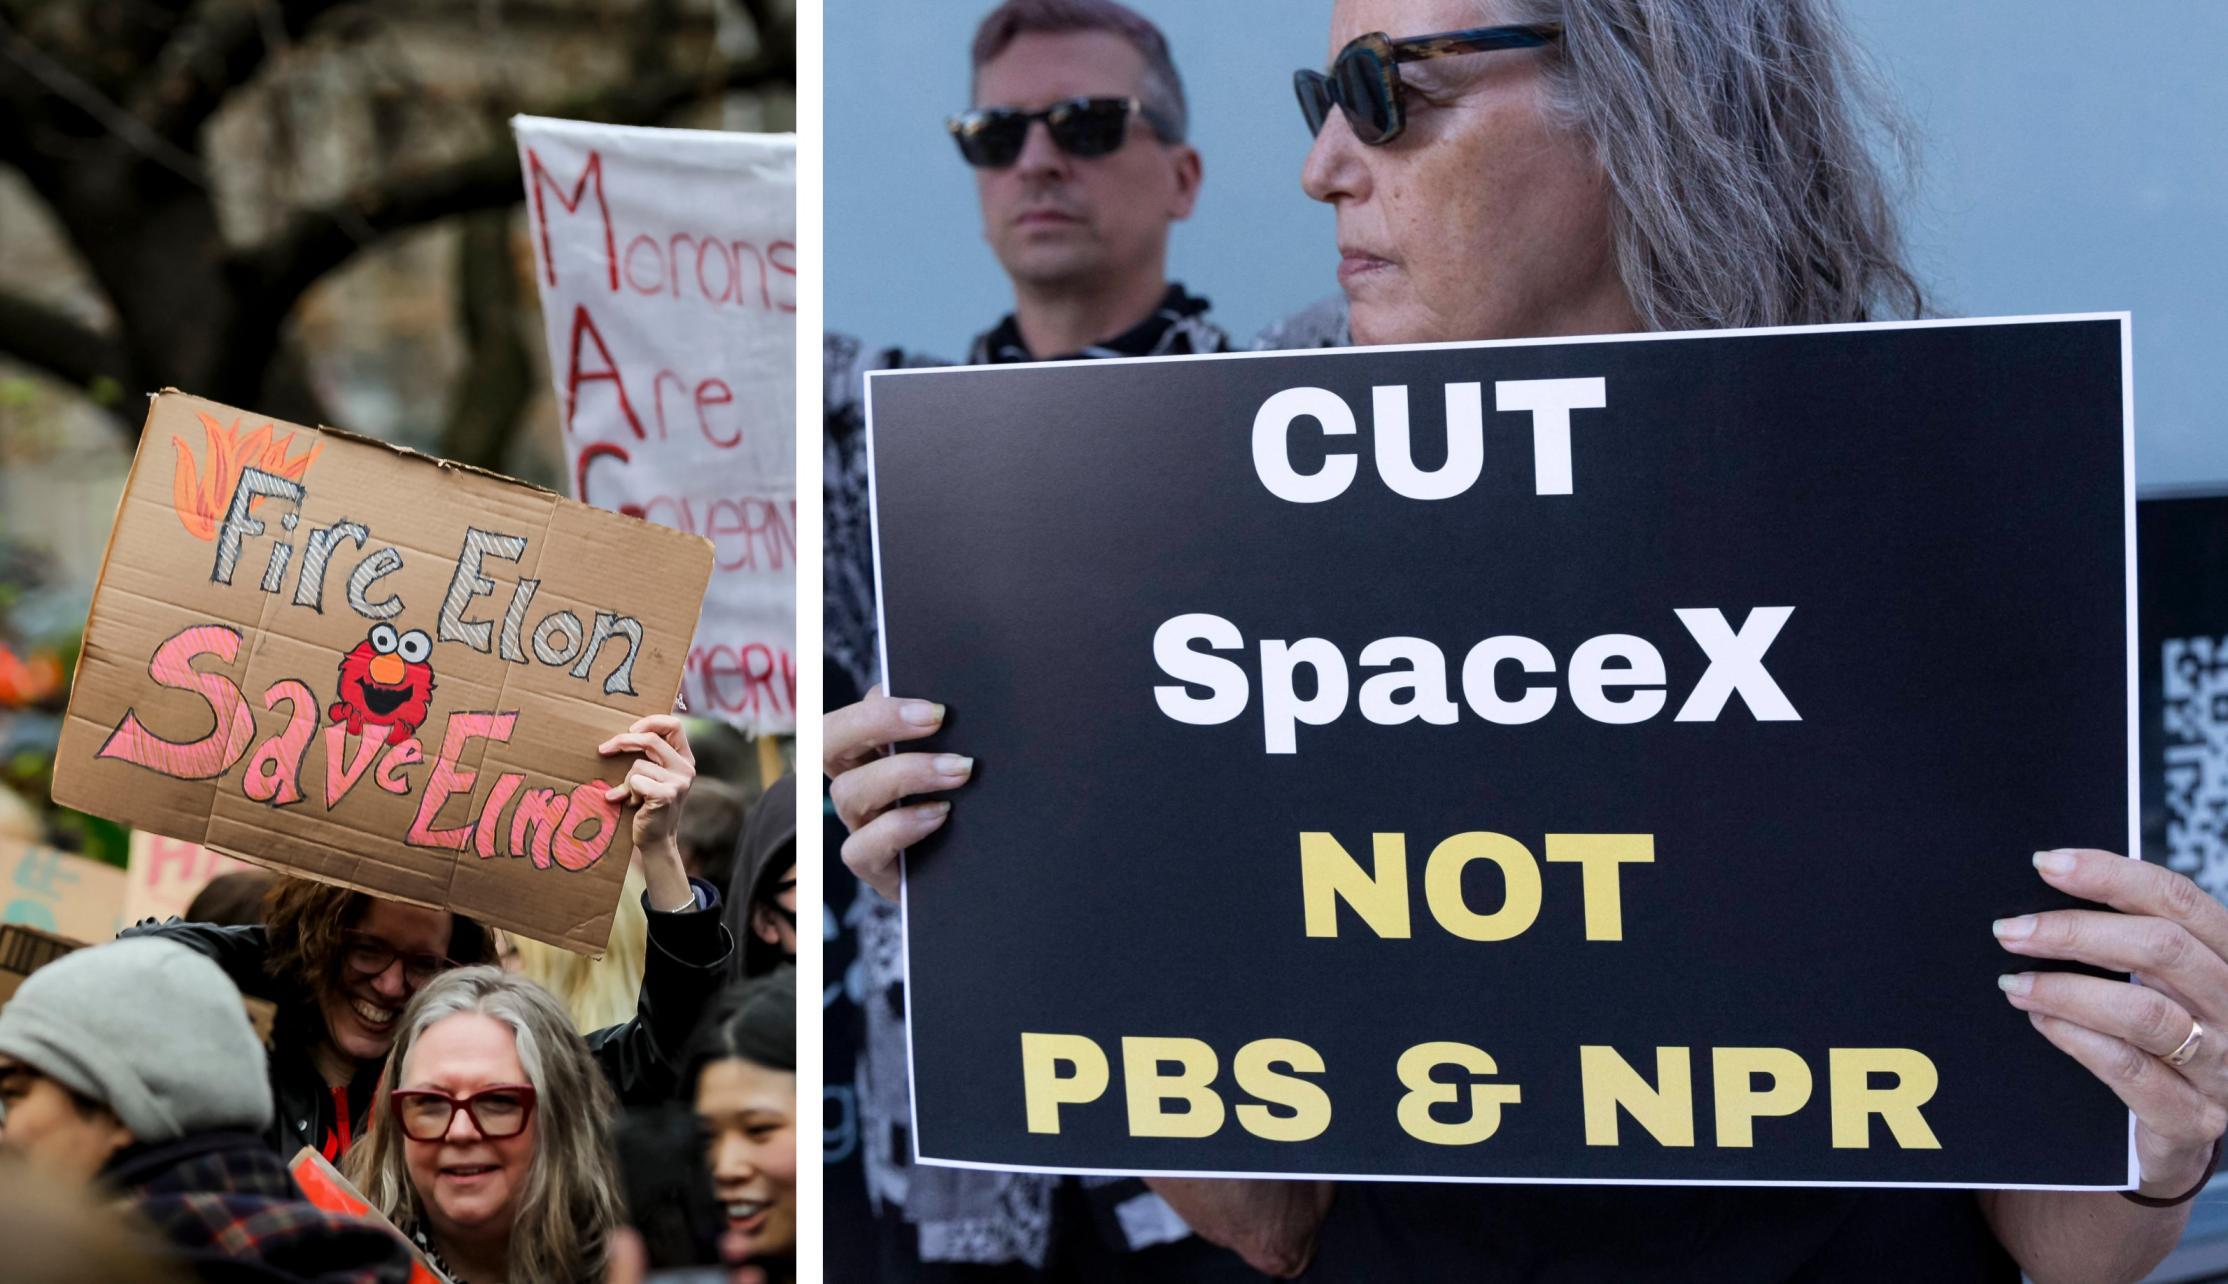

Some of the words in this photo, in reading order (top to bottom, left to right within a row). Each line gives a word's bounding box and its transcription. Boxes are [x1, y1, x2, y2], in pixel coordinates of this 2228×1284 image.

[566, 302, 742, 448] Are
[1252, 377, 1606, 503] CUT
[210, 466, 406, 621] Fire
[437, 525, 640, 697] Elon
[95, 624, 424, 812] Save
[404, 708, 623, 872] Elmo
[1153, 606, 1802, 754] SpaceX
[1300, 832, 1654, 941] NOT
[1021, 1033, 1331, 1141] PBS
[1397, 1042, 1521, 1145] &
[1580, 1046, 1941, 1149] NPR
